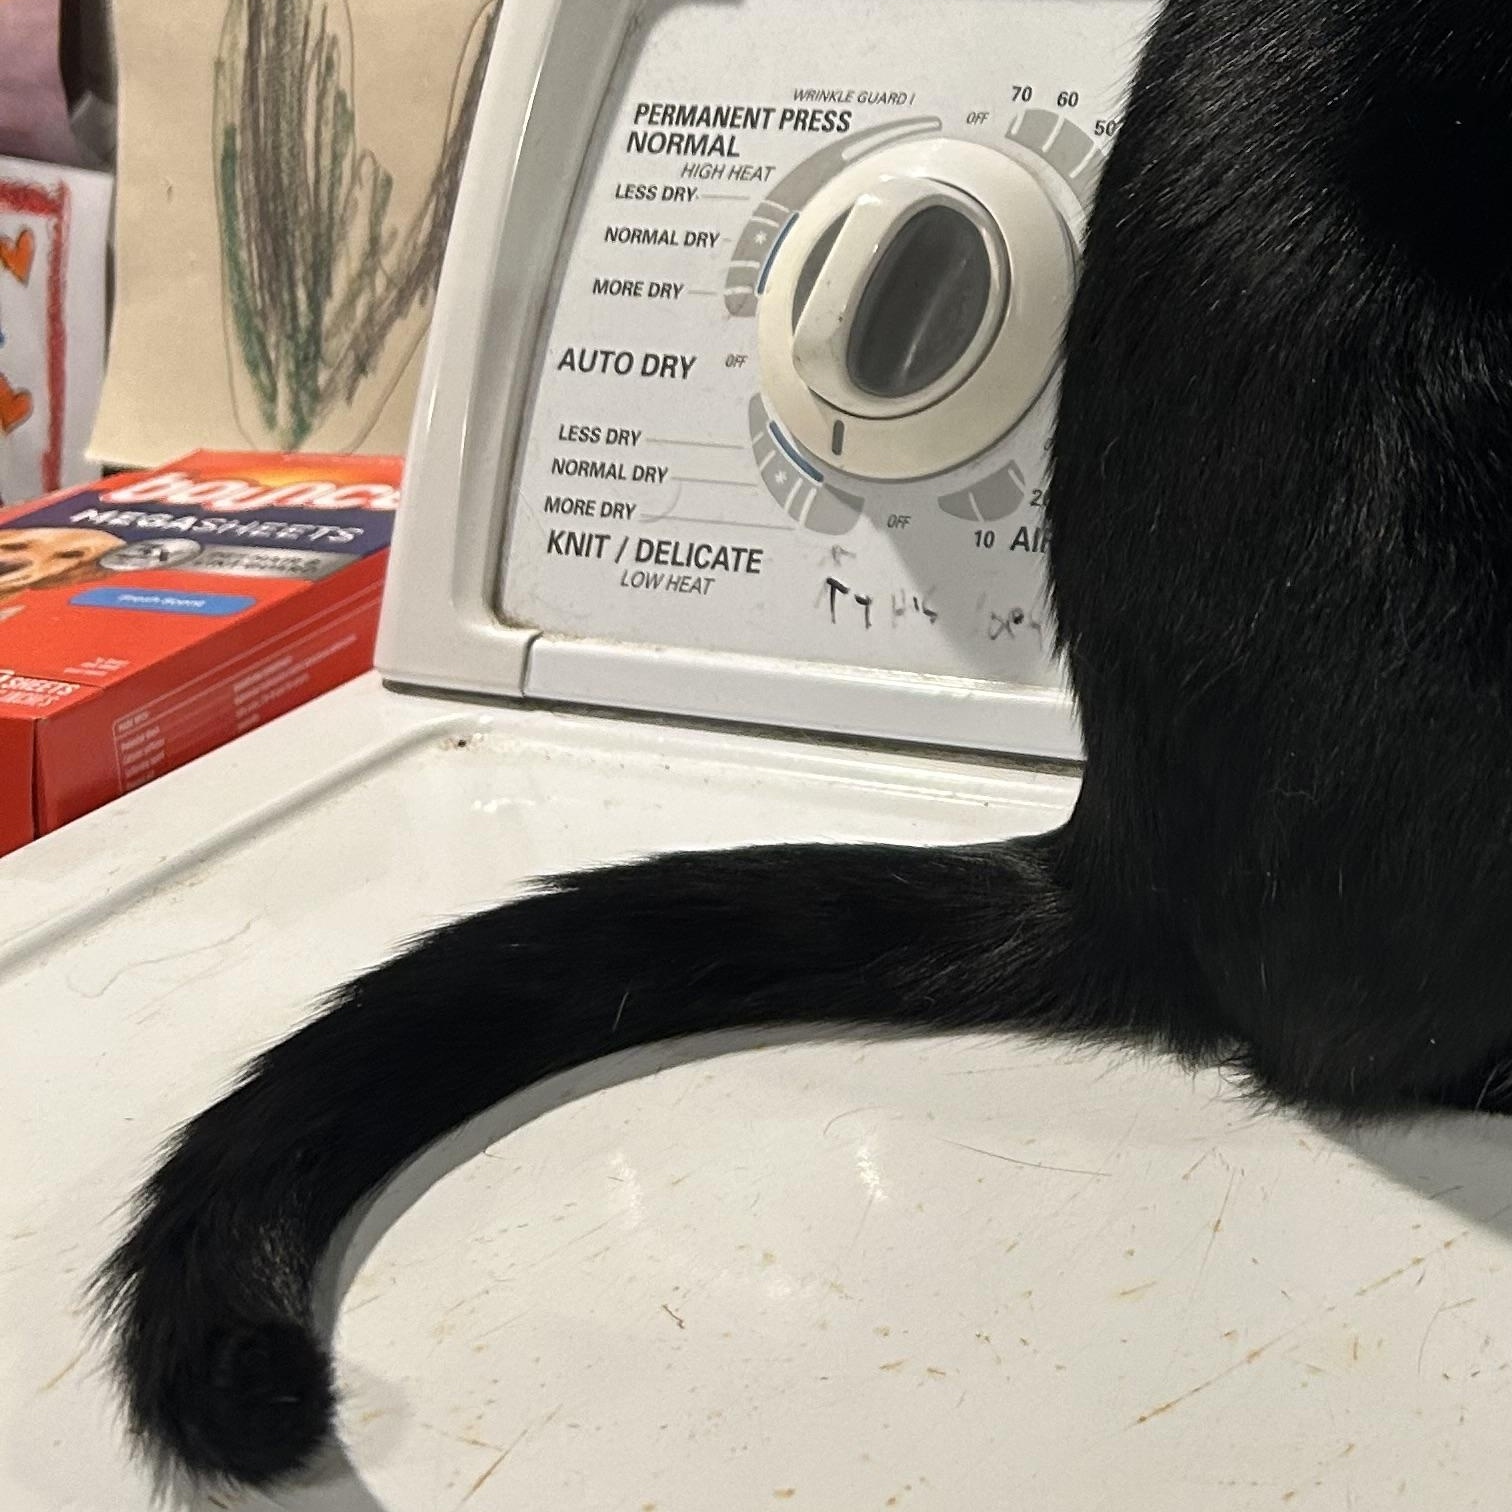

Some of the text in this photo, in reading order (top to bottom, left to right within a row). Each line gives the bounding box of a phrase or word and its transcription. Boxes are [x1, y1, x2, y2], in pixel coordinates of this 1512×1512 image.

[793, 88, 852, 103] WRINKLE
[857, 90, 909, 105] GUARD
[1010, 85, 1033, 103] 70
[1056, 90, 1080, 109] 60
[633, 102, 853, 134] PERMANENT PRESS
[966, 110, 990, 126] OFF
[1093, 118, 1117, 138] 50
[626, 131, 741, 158] NORMAL
[680, 162, 776, 183] HIGH HEAT
[614, 183, 698, 203] LESS DRY
[604, 226, 720, 249] NORMAL DRY
[592, 278, 684, 300] MORE DRY
[557, 347, 698, 380] AUTO DRY
[725, 354, 749, 369] OFF
[558, 423, 642, 447] LESS DRY
[551, 457, 668, 485] NORMAL DRY
[544, 495, 637, 521] MORE DRY
[70, 507, 365, 544] MEGASHEETS
[887, 513, 912, 529] OFF
[973, 528, 996, 550] 10
[547, 528, 611, 560] KNIT
[635, 537, 764, 574] DELICATE
[620, 568, 716, 596] LOW HEAT
